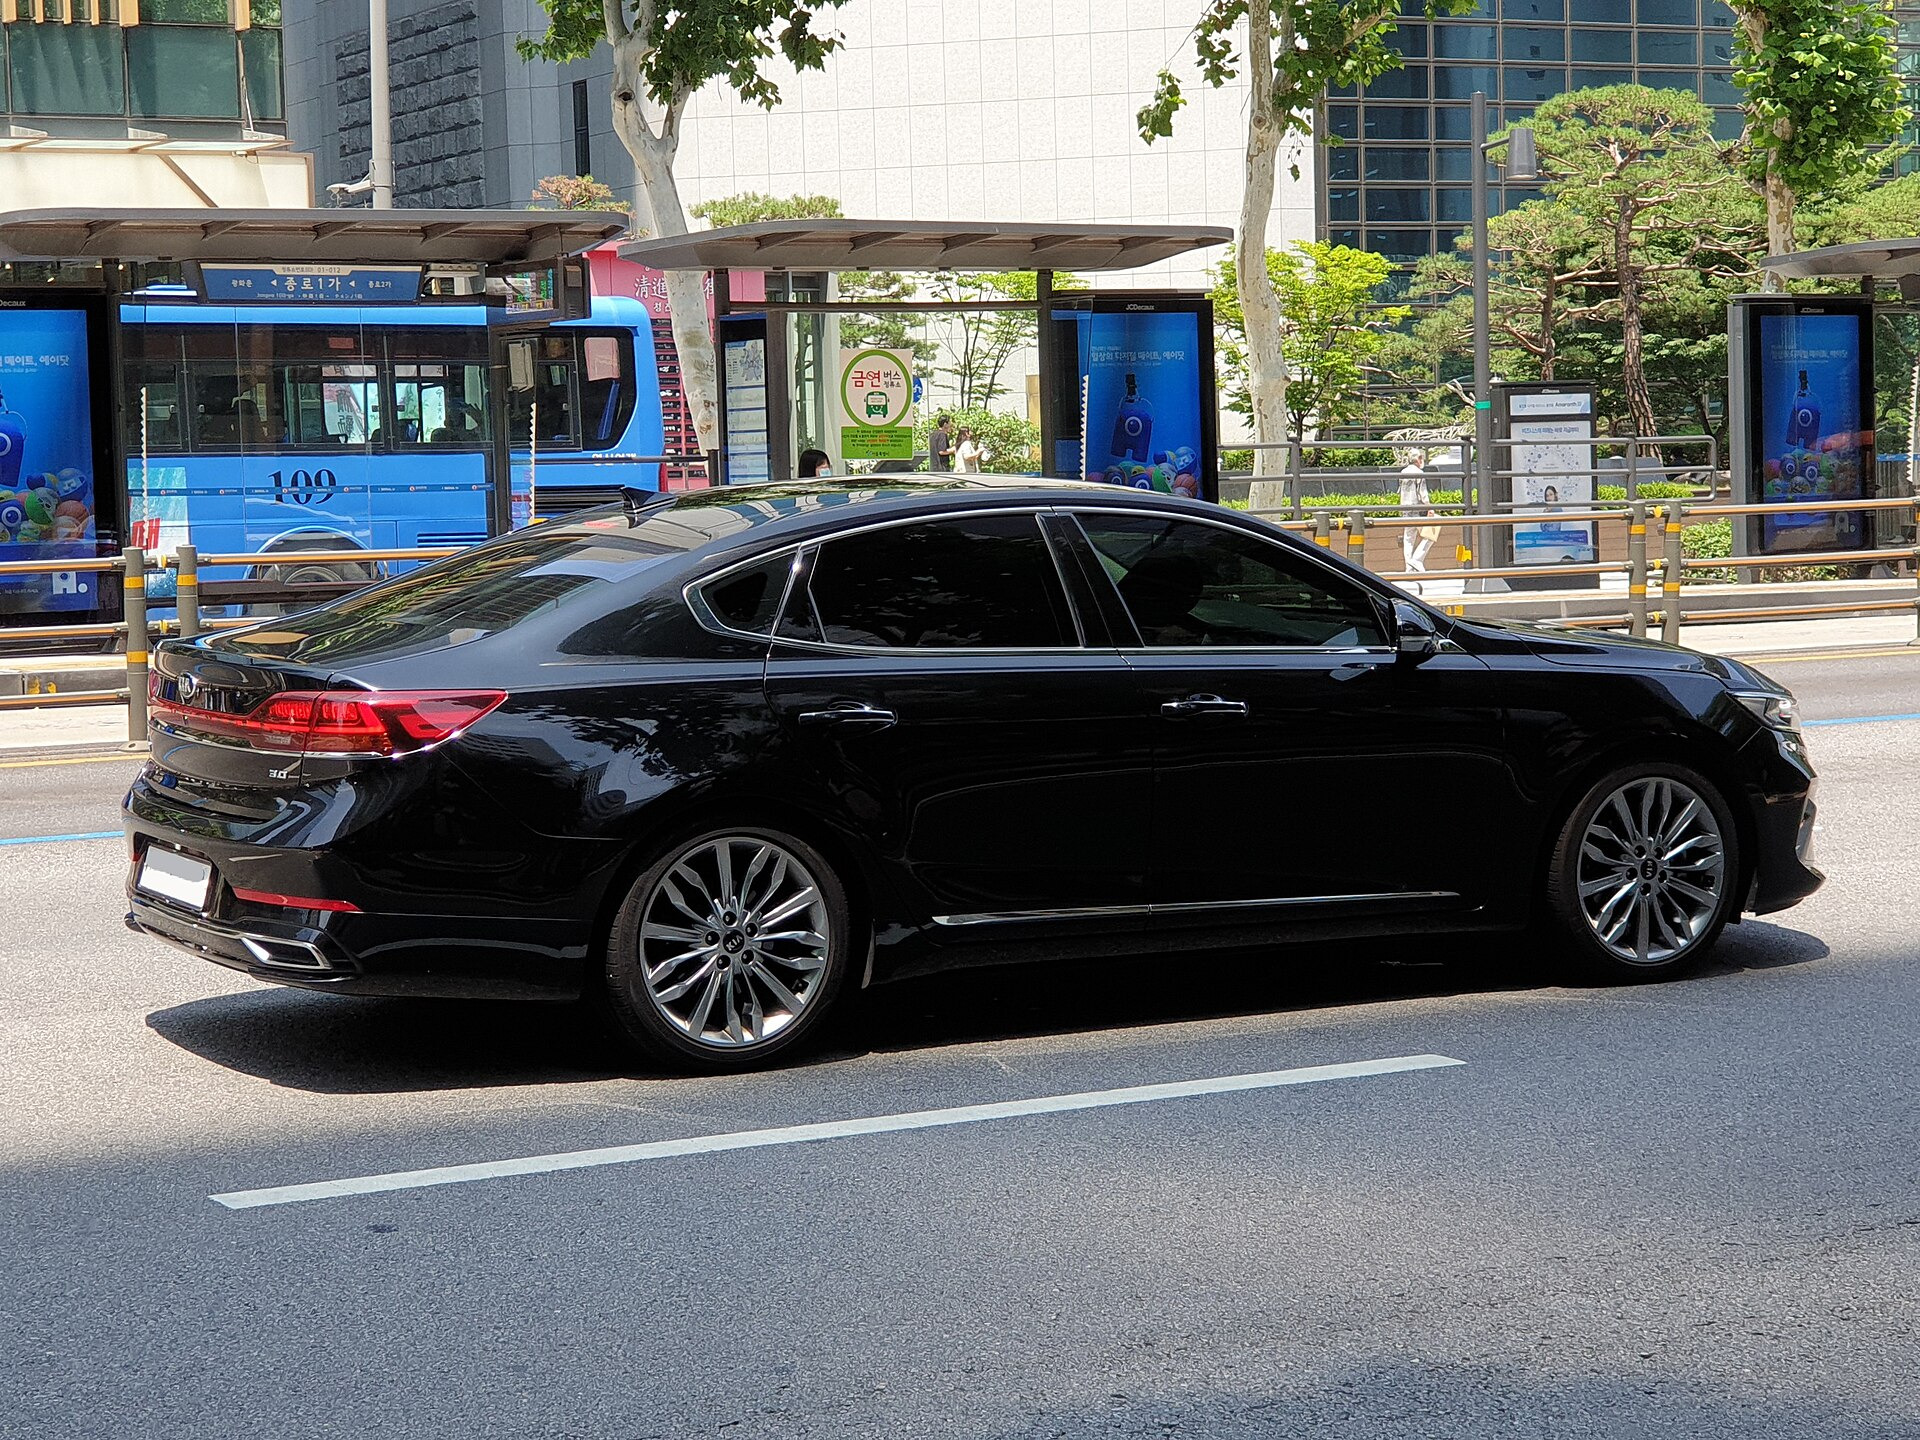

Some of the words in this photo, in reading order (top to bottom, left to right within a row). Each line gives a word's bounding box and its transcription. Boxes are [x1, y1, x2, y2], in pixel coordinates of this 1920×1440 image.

[284, 276, 341, 291] 종로1가
[368, 280, 392, 289] 종로2가
[1125, 303, 1155, 311] JCDecaux
[4, 355, 37, 366] 메이트,
[851, 370, 881, 388] 금연
[883, 370, 902, 381] 버스
[883, 380, 902, 389] 정류소
[267, 468, 337, 505] 109
[725, 934, 744, 952] KIA
